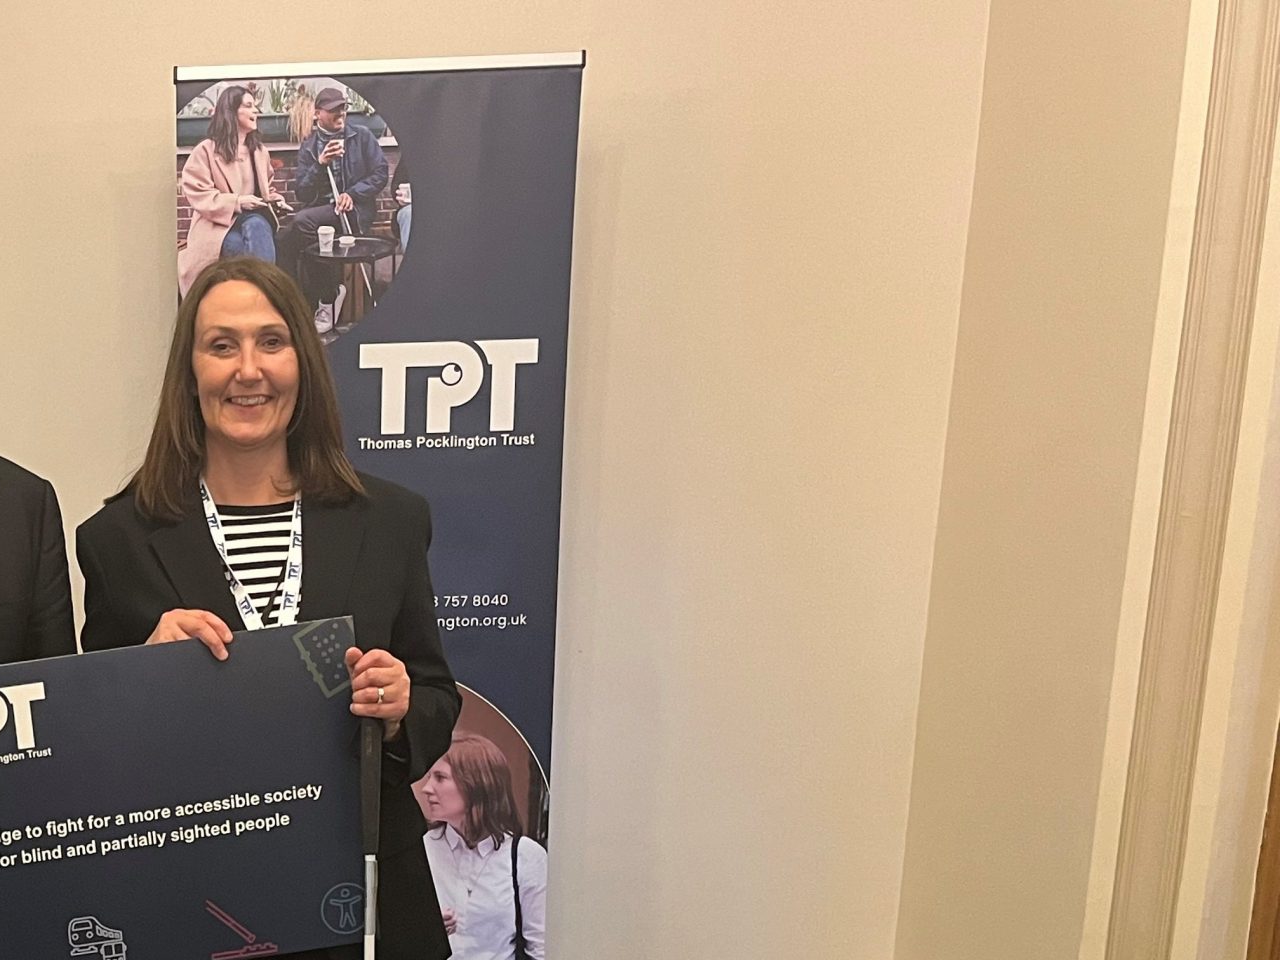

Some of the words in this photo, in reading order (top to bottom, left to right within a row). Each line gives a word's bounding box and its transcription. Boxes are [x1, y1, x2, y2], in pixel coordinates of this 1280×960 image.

[359, 338, 539, 434] TPT
[358, 438, 412, 450] Thomas
[416, 436, 497, 450] Pocklington
[501, 433, 535, 446] Trust
[443, 596, 468, 607] 757
[472, 594, 508, 607] 8040
[437, 613, 527, 631] ngton.org.uk
[26, 747, 52, 759] Trust
[25, 825, 43, 839] to
[46, 817, 85, 837] fight
[87, 815, 111, 830] for
[115, 814, 125, 826] a
[128, 807, 171, 824] more
[175, 792, 260, 817] accessible
[264, 783, 322, 804] society
[21, 845, 62, 864] blind
[66, 840, 97, 857] and
[101, 830, 166, 855] partially
[170, 820, 231, 843] sighted
[235, 813, 290, 836] people
